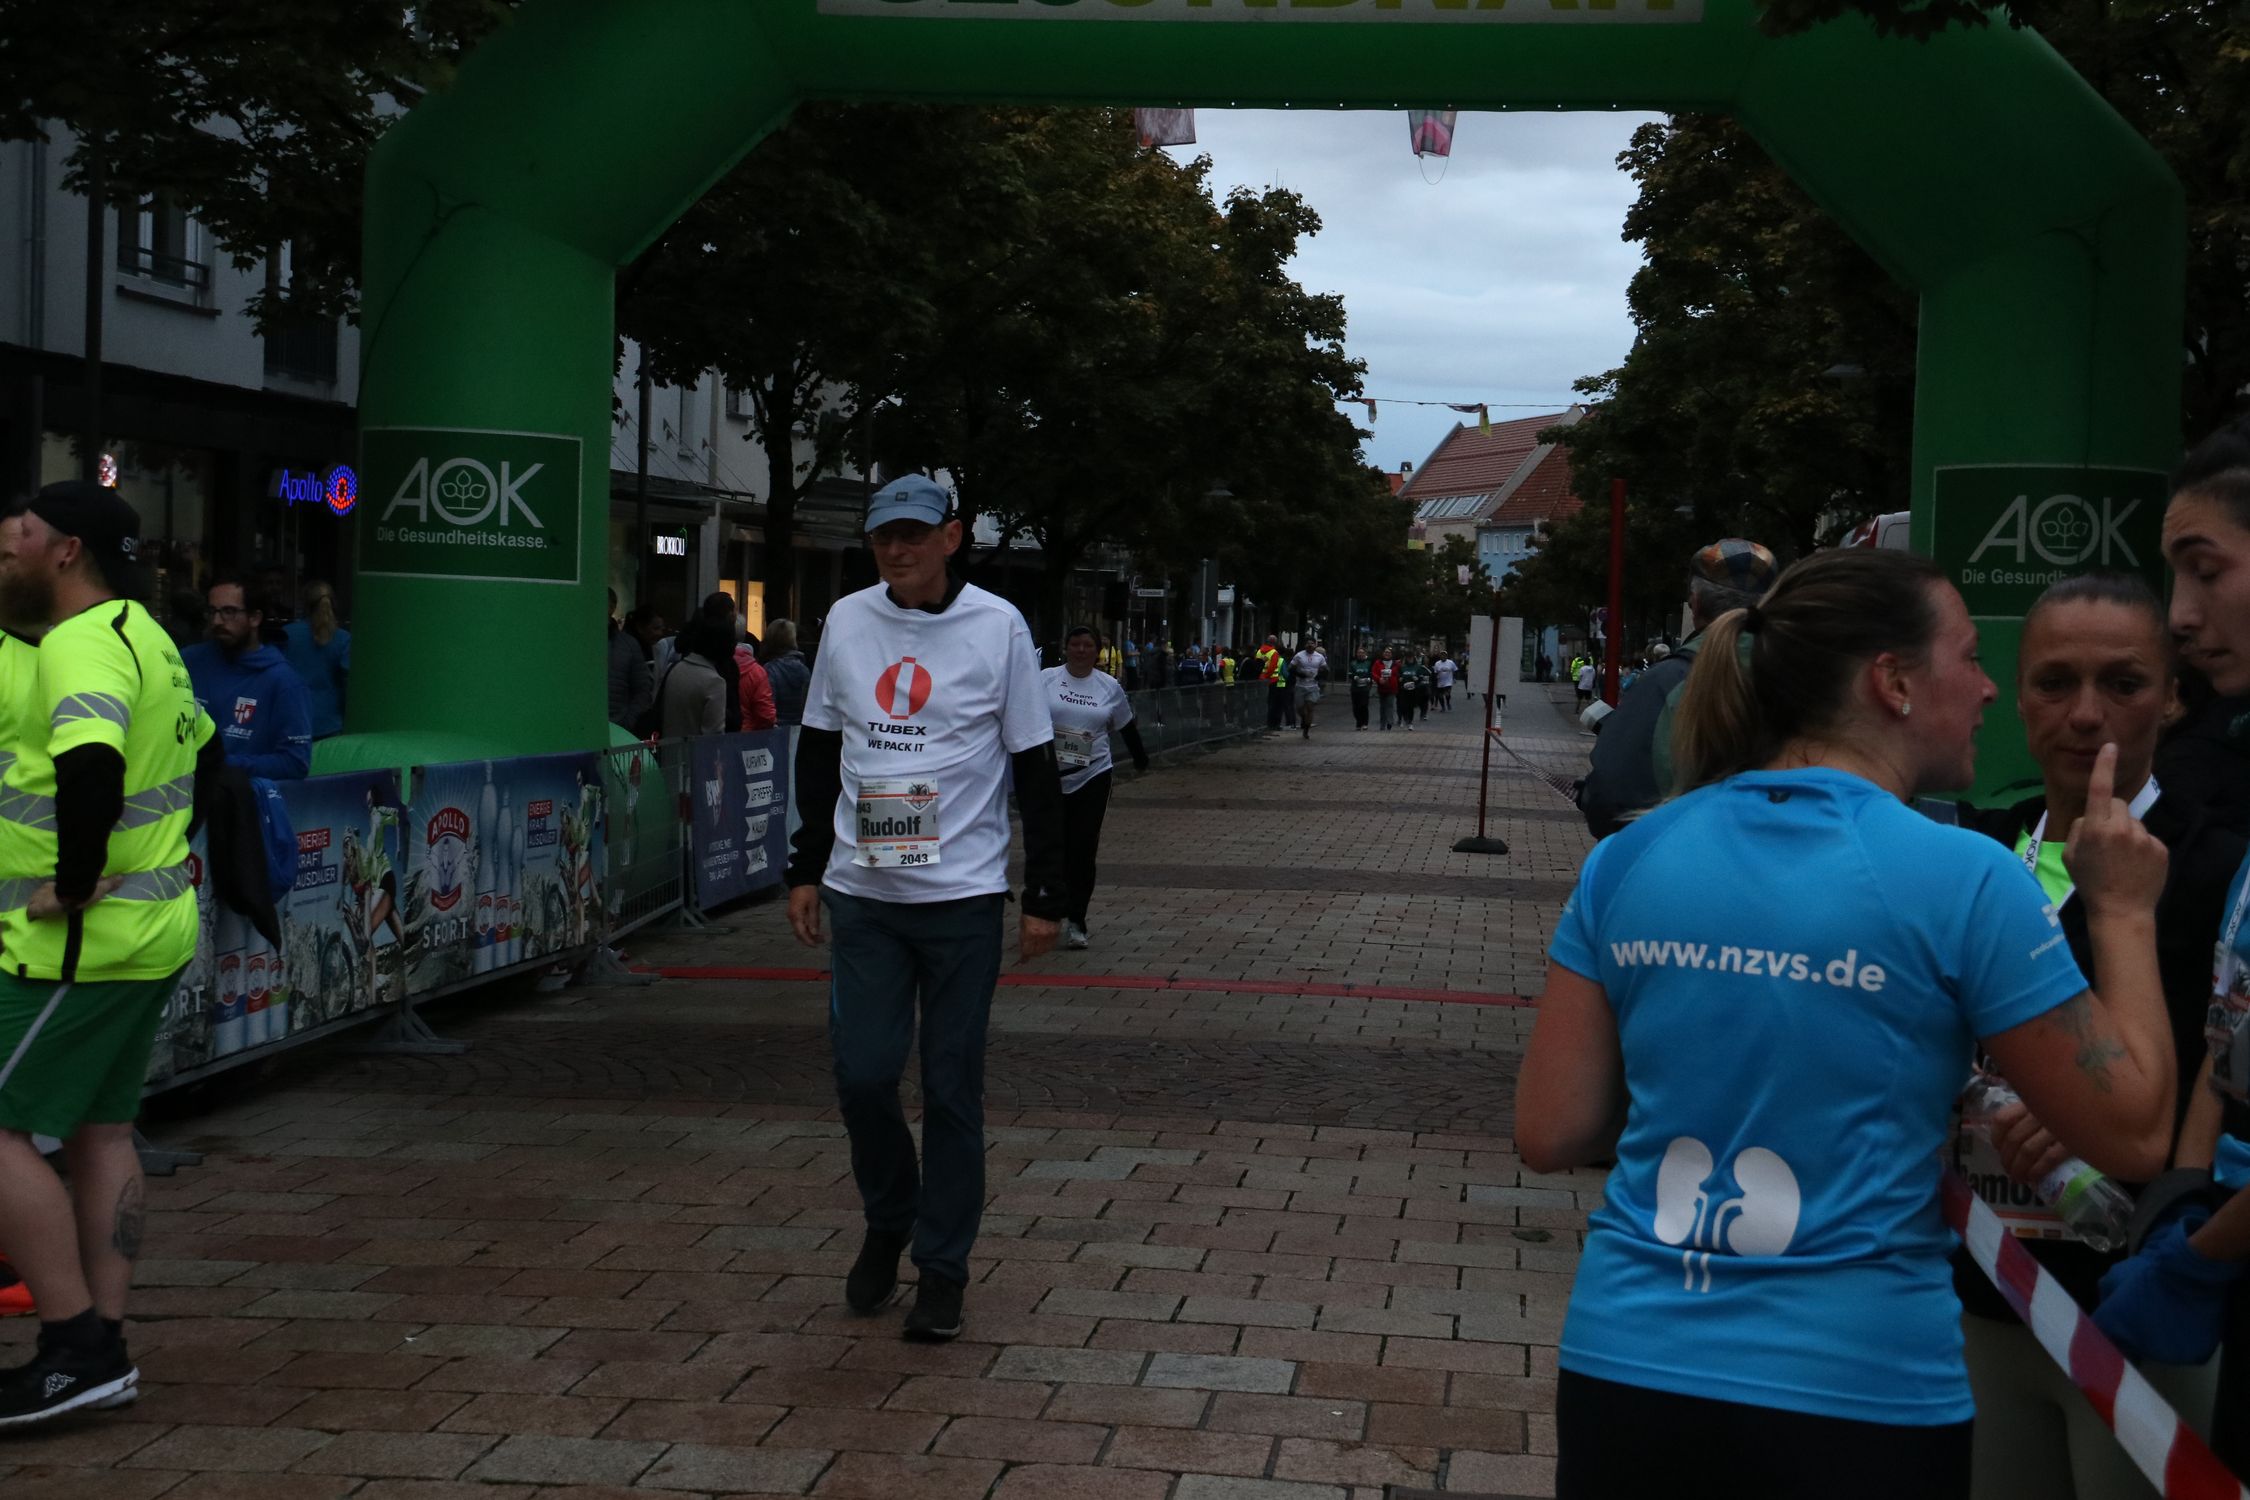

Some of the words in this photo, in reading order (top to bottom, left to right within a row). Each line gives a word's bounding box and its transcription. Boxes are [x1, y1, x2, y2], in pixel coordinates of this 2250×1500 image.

[279, 468, 323, 506] Apollo
[380, 457, 544, 528] AOK
[377, 526, 395, 542] Die
[399, 527, 548, 549] Gesundheitskasse.
[1967, 494, 2142, 567] AOK
[1962, 568, 1986, 584] Die
[1059, 694, 1098, 707] Vantive
[1069, 691, 1093, 699] Team
[868, 722, 927, 735] TUBEX
[868, 739, 882, 749] WE
[884, 740, 911, 751] PACK
[914, 743, 925, 752] IT
[431, 812, 465, 840] APOLLO
[861, 816, 921, 837] Rudolf
[901, 853, 928, 865] 2043
[1610, 940, 1886, 992] www.nzvs.de
